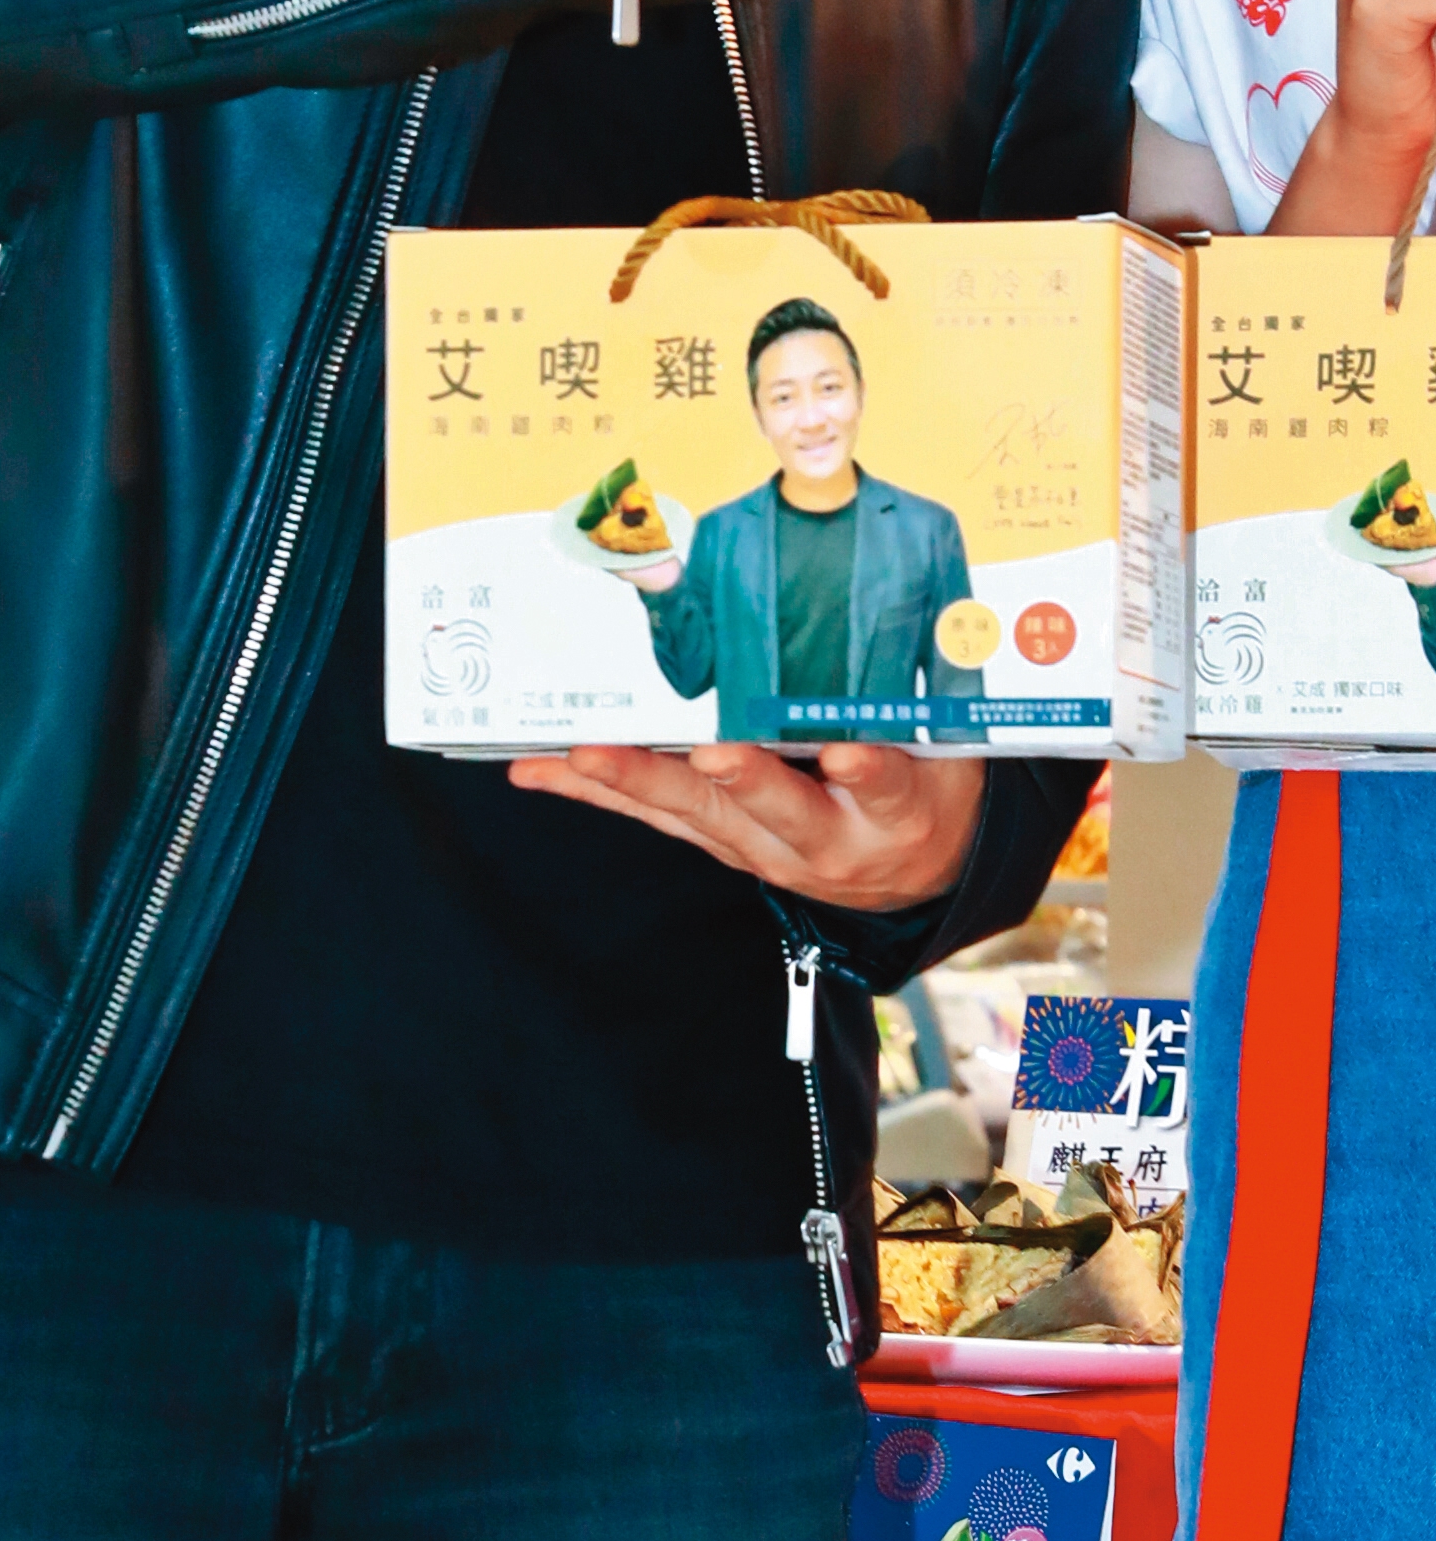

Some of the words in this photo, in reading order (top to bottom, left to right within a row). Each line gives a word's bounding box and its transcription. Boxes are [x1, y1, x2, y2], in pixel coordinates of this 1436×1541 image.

[426, 336, 717, 402] 艾喫雞
[1207, 417, 1390, 439] 海南雞肉粽
